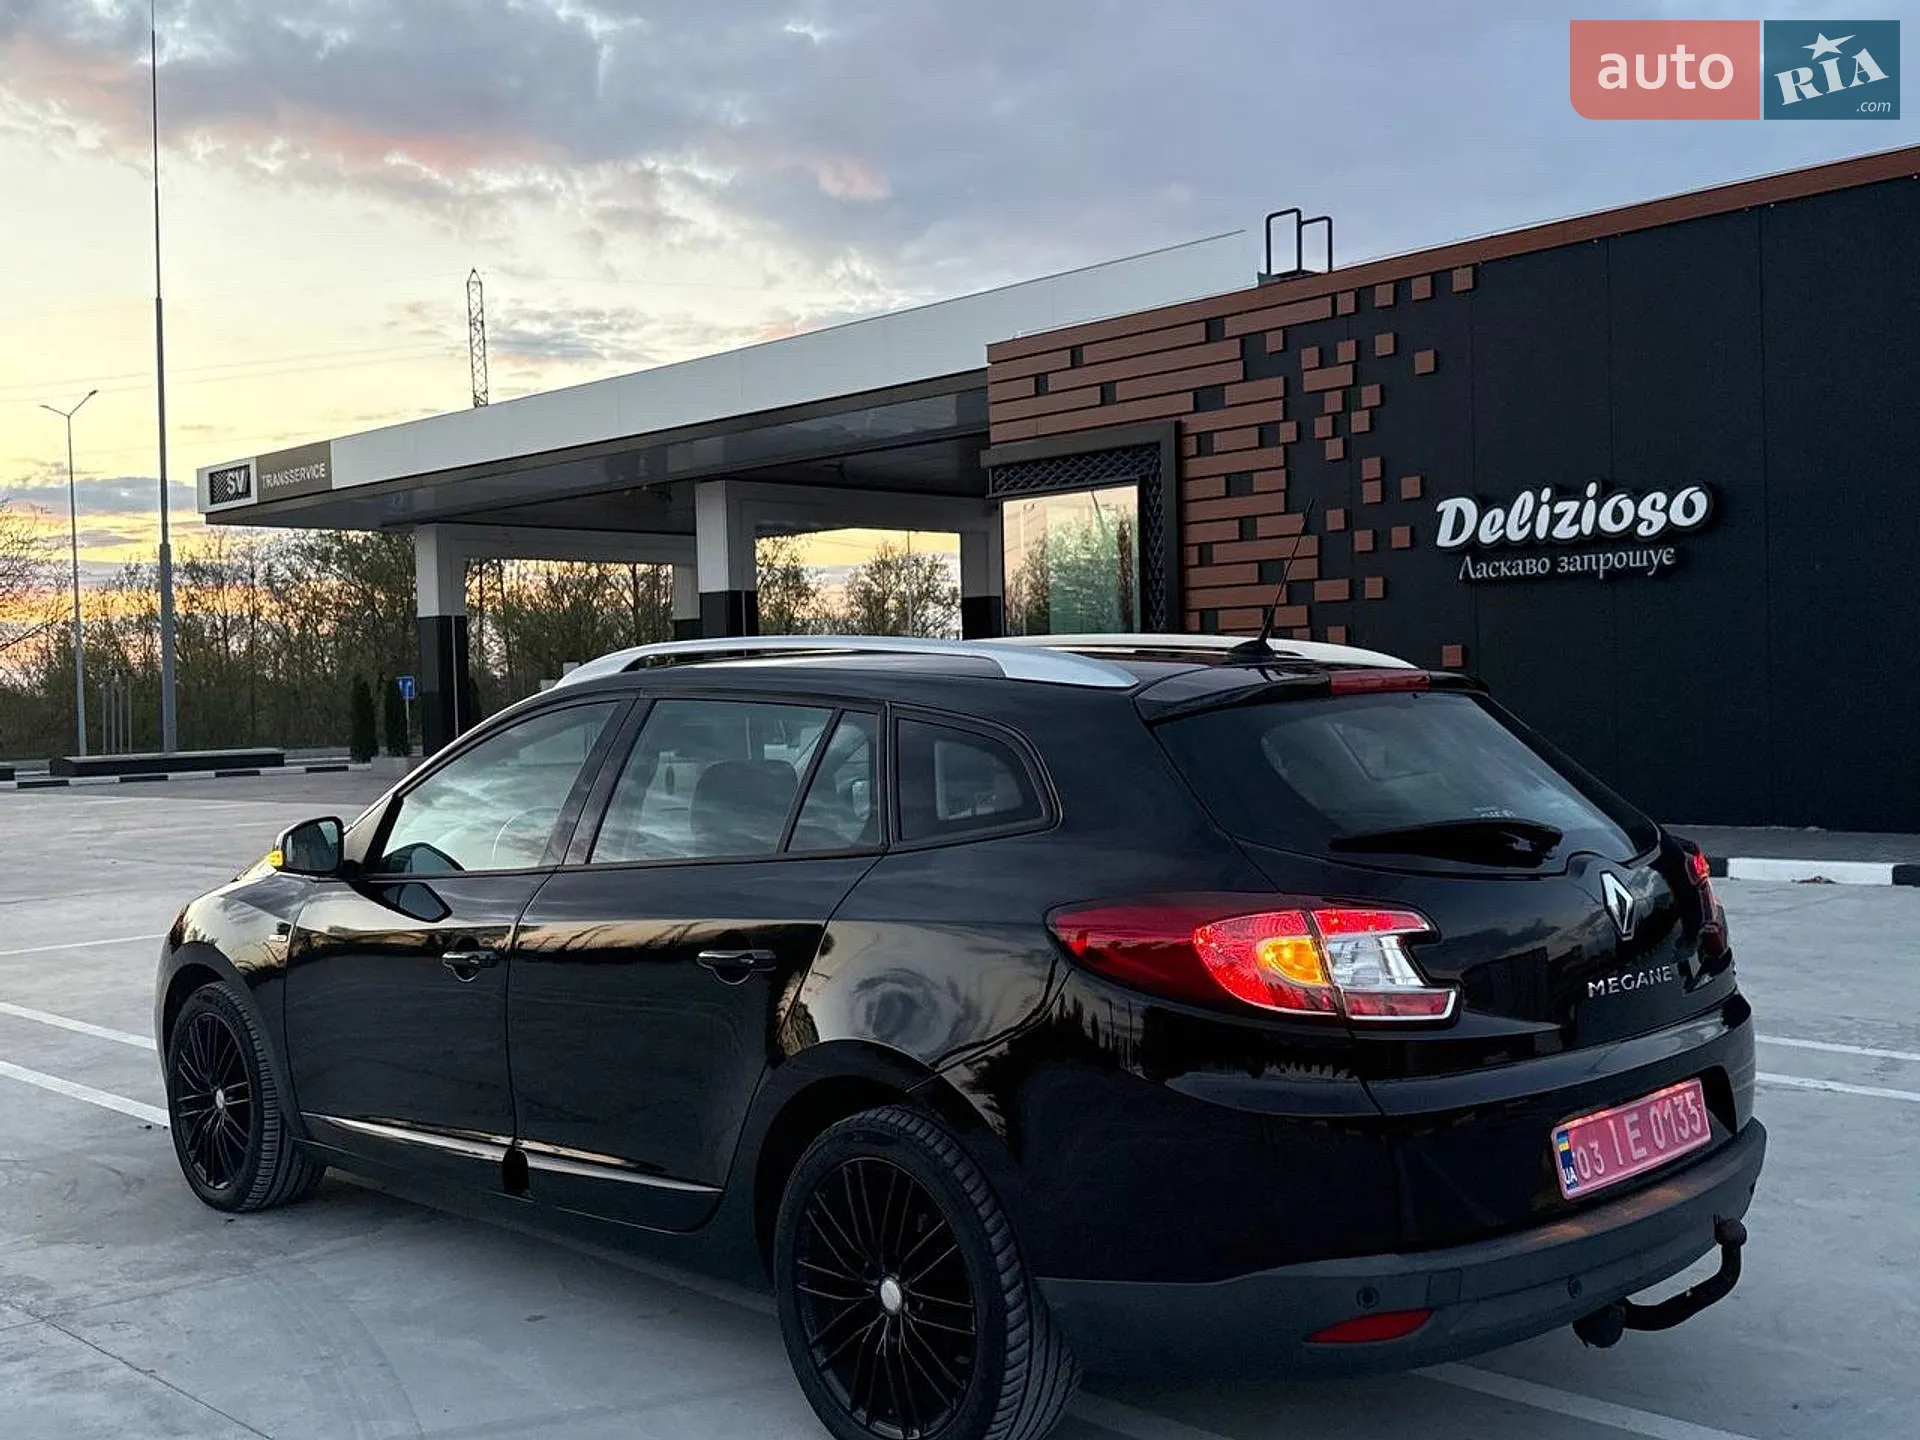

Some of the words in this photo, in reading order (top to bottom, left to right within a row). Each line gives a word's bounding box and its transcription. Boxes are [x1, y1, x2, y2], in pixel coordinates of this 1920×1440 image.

[261, 463, 326, 489] TRANSSERVICE
[1436, 482, 1708, 547] Delizioso
[1459, 556, 1551, 580] Ласкаво
[1557, 547, 1676, 580] запрошує
[1587, 966, 1673, 998] MEGANE
[1576, 1140, 1605, 1180] 03
[1650, 1091, 1702, 1150] 0135
[1562, 1166, 1578, 1185] UA
